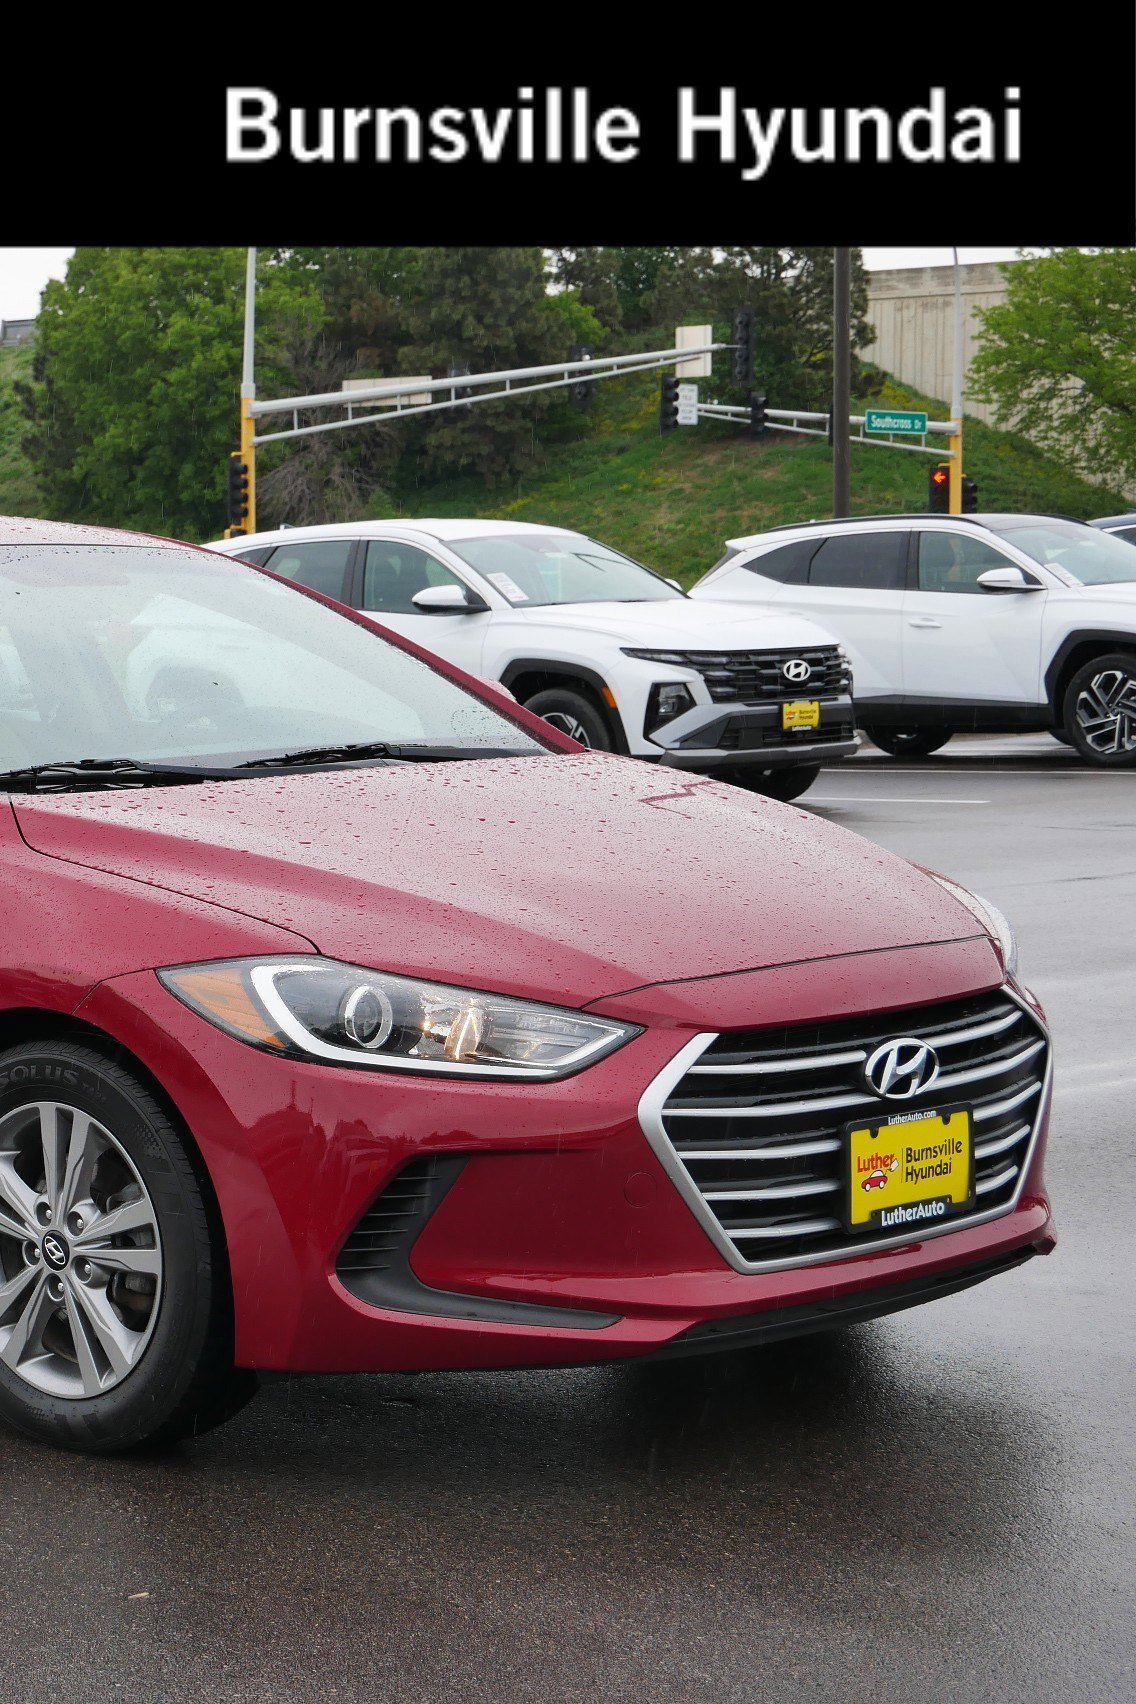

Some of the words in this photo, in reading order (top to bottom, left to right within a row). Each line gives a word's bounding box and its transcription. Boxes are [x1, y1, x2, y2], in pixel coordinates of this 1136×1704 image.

[870, 414, 912, 429] Southcross
[914, 419, 922, 429] Dr
[888, 1110, 937, 1125] LutherAuto.com
[857, 1152, 895, 1173] Luther
[905, 1138, 963, 1164] Burnsville
[905, 1157, 953, 1185] Hyundai
[881, 1201, 945, 1227] LutherAuto
